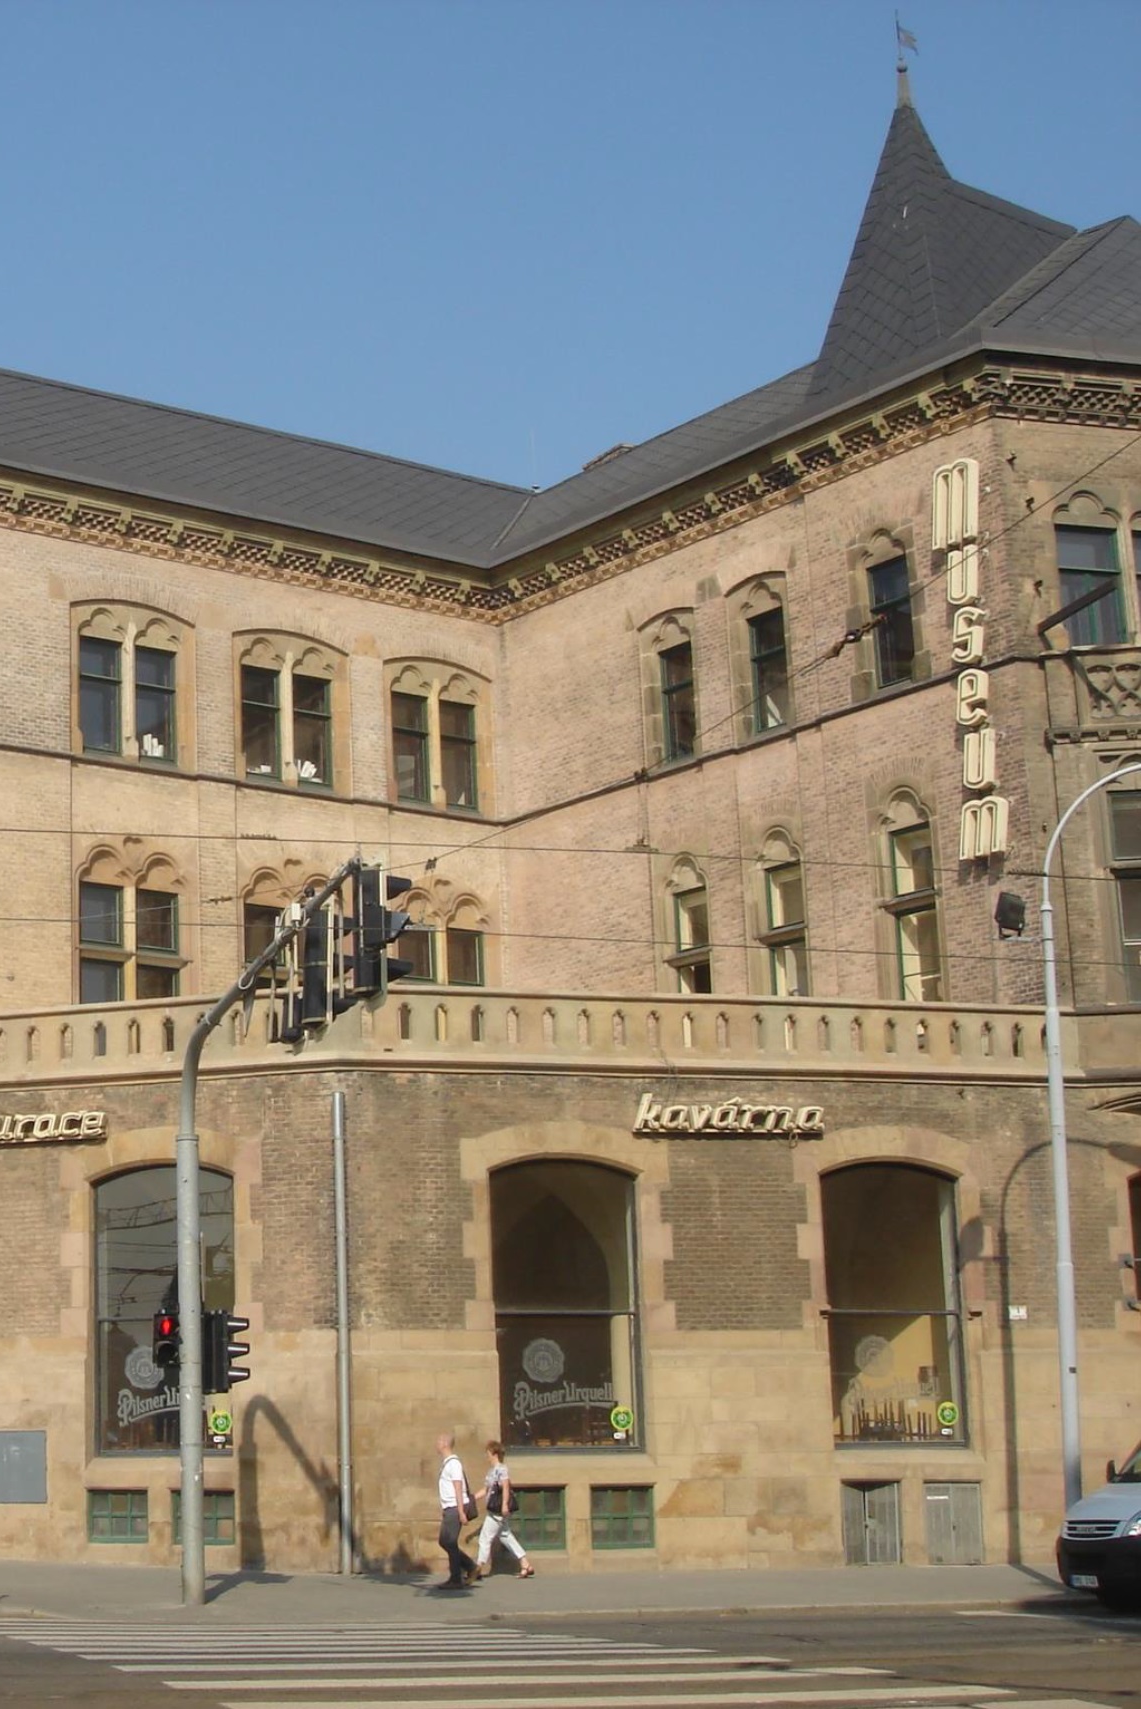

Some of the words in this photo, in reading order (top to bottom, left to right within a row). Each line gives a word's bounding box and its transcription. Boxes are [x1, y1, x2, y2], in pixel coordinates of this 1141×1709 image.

[634, 1092, 826, 1131] kavárna
[117, 1388, 166, 1428] Pilsner
[514, 1381, 563, 1420] Pilsner
[563, 1380, 614, 1406] Urquell
